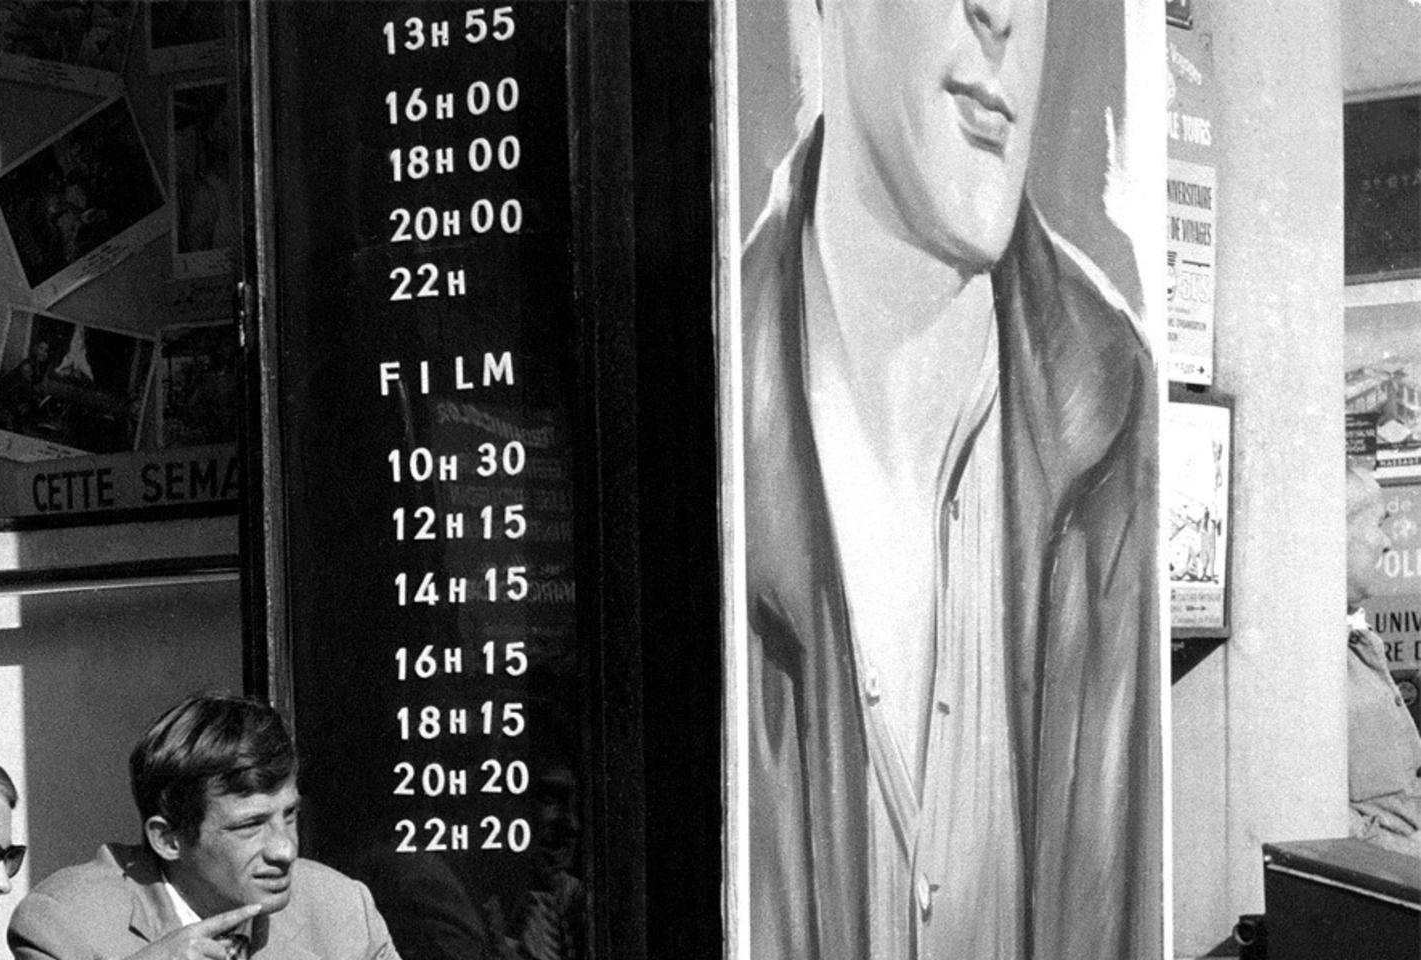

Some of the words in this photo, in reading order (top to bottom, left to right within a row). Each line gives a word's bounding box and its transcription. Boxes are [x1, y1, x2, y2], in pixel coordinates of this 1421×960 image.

[383, 16, 449, 55] 13H
[465, 6, 515, 44] 55
[385, 87, 454, 125] 16H
[466, 77, 519, 115] 00
[389, 145, 454, 182] 18H
[468, 135, 521, 172] 00
[389, 206, 461, 243] 20H
[470, 198, 523, 234] 00
[389, 262, 466, 301] 22H
[379, 351, 515, 396] FILM
[388, 447, 458, 483] 10H
[476, 440, 526, 477] 30
[32, 468, 113, 512] CETTE
[392, 505, 464, 541] 12H
[480, 503, 527, 540] 15
[394, 572, 468, 606] 14H
[484, 565, 529, 603] 15
[395, 644, 462, 681] 16H
[482, 640, 528, 677] 15
[397, 705, 467, 740] 18H
[480, 700, 525, 737] 15
[393, 761, 467, 797] 20H
[480, 758, 530, 795] 20
[394, 817, 469, 853] 22H
[479, 815, 531, 853] 20
